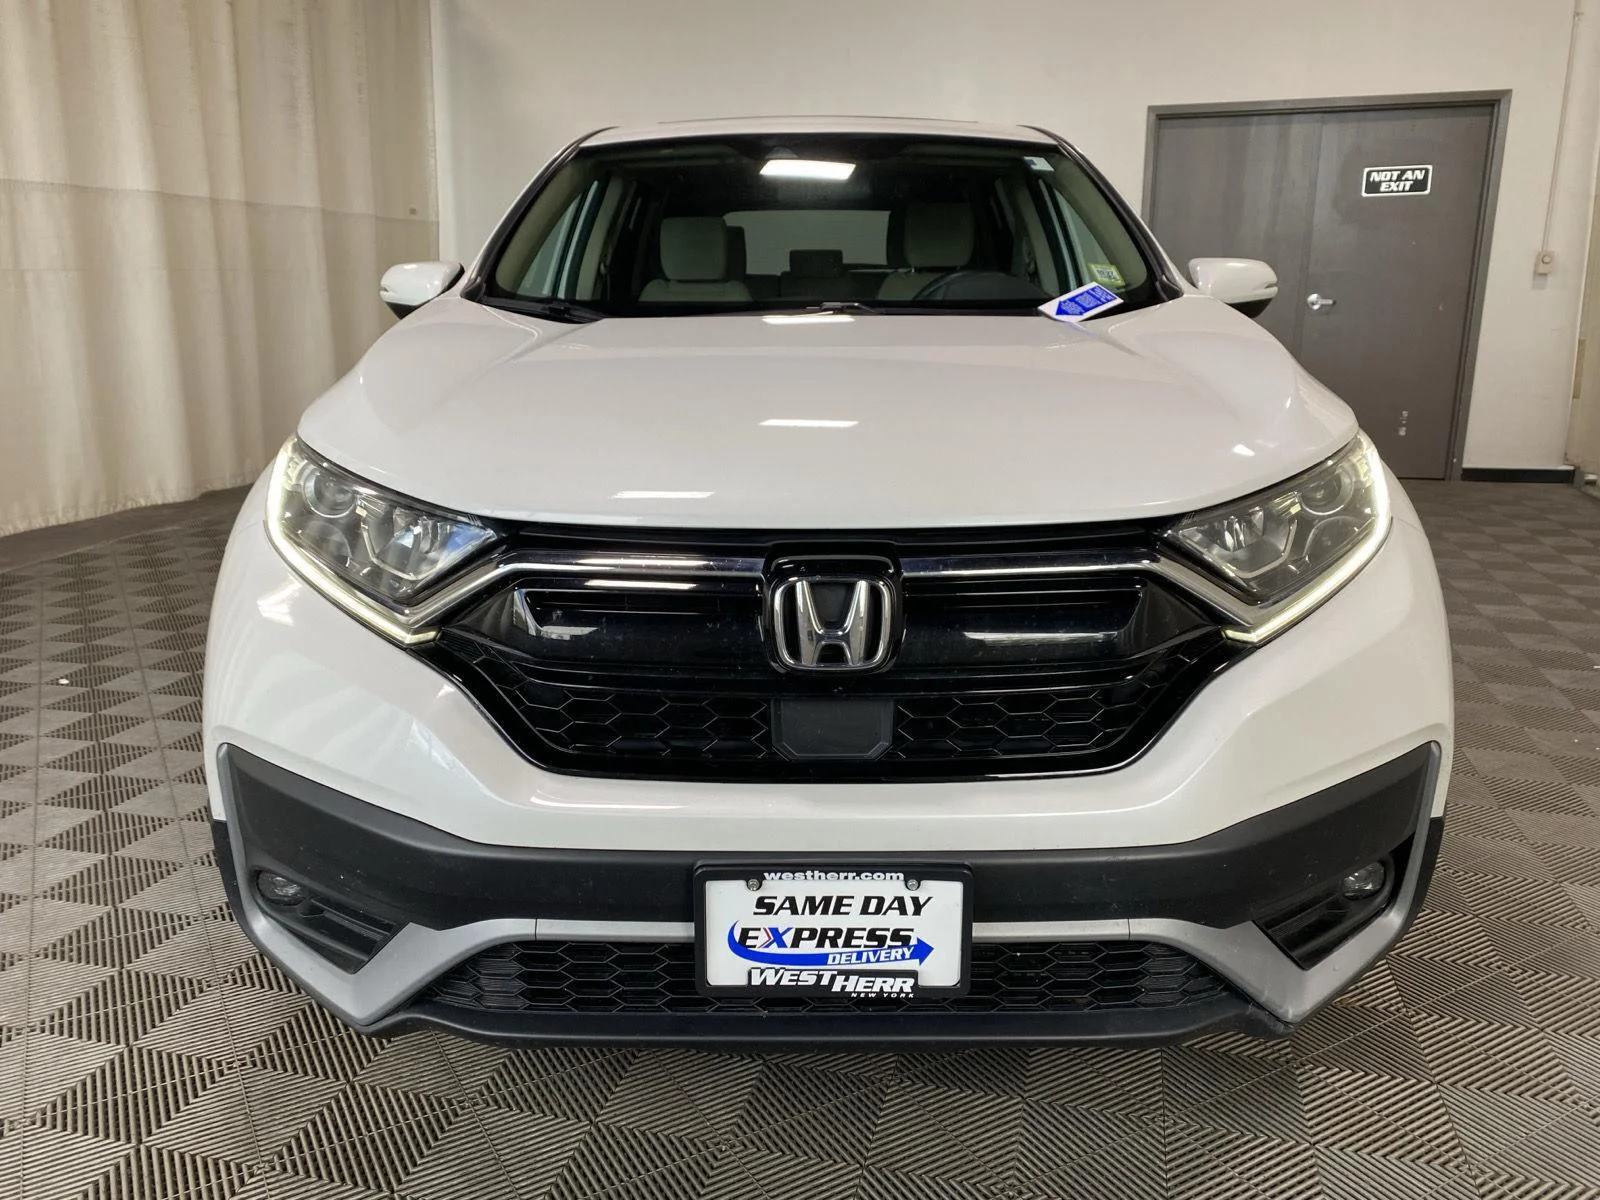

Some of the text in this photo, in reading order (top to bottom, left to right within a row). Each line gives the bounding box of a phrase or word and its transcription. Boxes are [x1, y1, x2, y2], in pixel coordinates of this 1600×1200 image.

[1370, 170, 1425, 182] NOT AN
[1380, 181, 1413, 192] EXIT
[763, 870, 905, 881] westherr.com
[753, 895, 934, 917] SAME DAY
[738, 927, 915, 949] EXPRESS
[827, 947, 915, 965] DELIVERY
